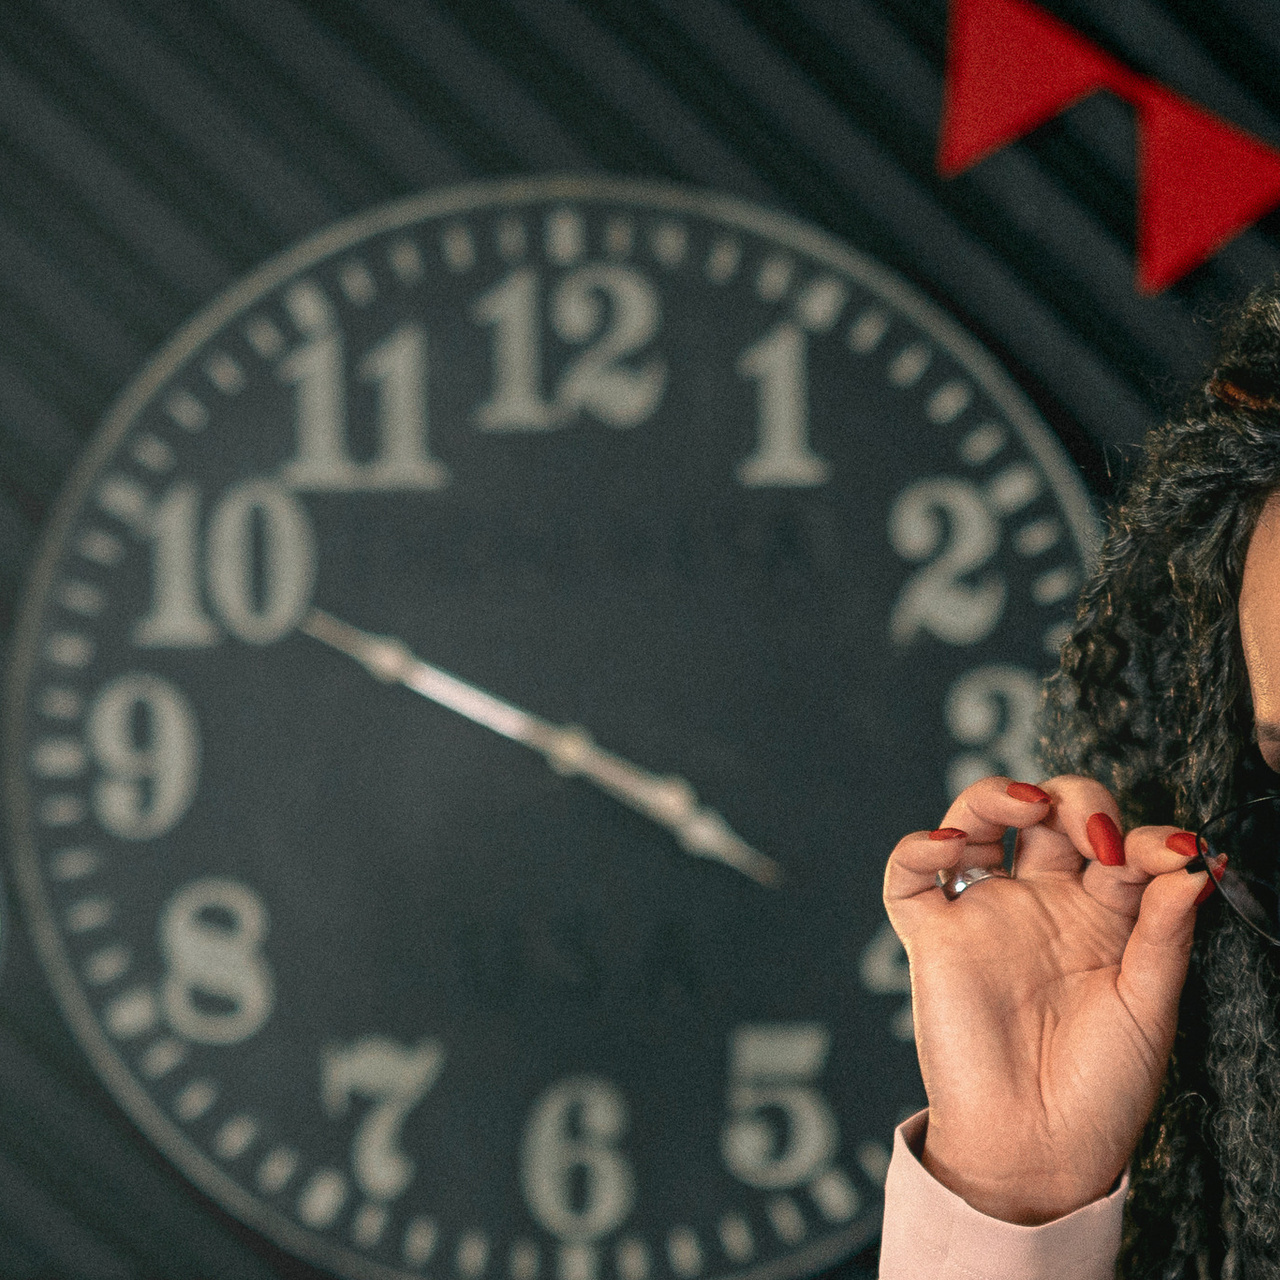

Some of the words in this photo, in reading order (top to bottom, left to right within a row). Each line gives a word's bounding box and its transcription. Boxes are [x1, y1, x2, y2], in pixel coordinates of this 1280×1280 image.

[276, 326, 450, 490] 11
[473, 266, 667, 431] 12
[736, 322, 833, 487] 1
[132, 479, 319, 647] 10
[889, 478, 1006, 646] 2
[88, 674, 197, 841] 9
[161, 879, 273, 1045] 8
[321, 1037, 445, 1196] 7
[521, 1076, 635, 1242] 6
[723, 1023, 837, 1189] 5
